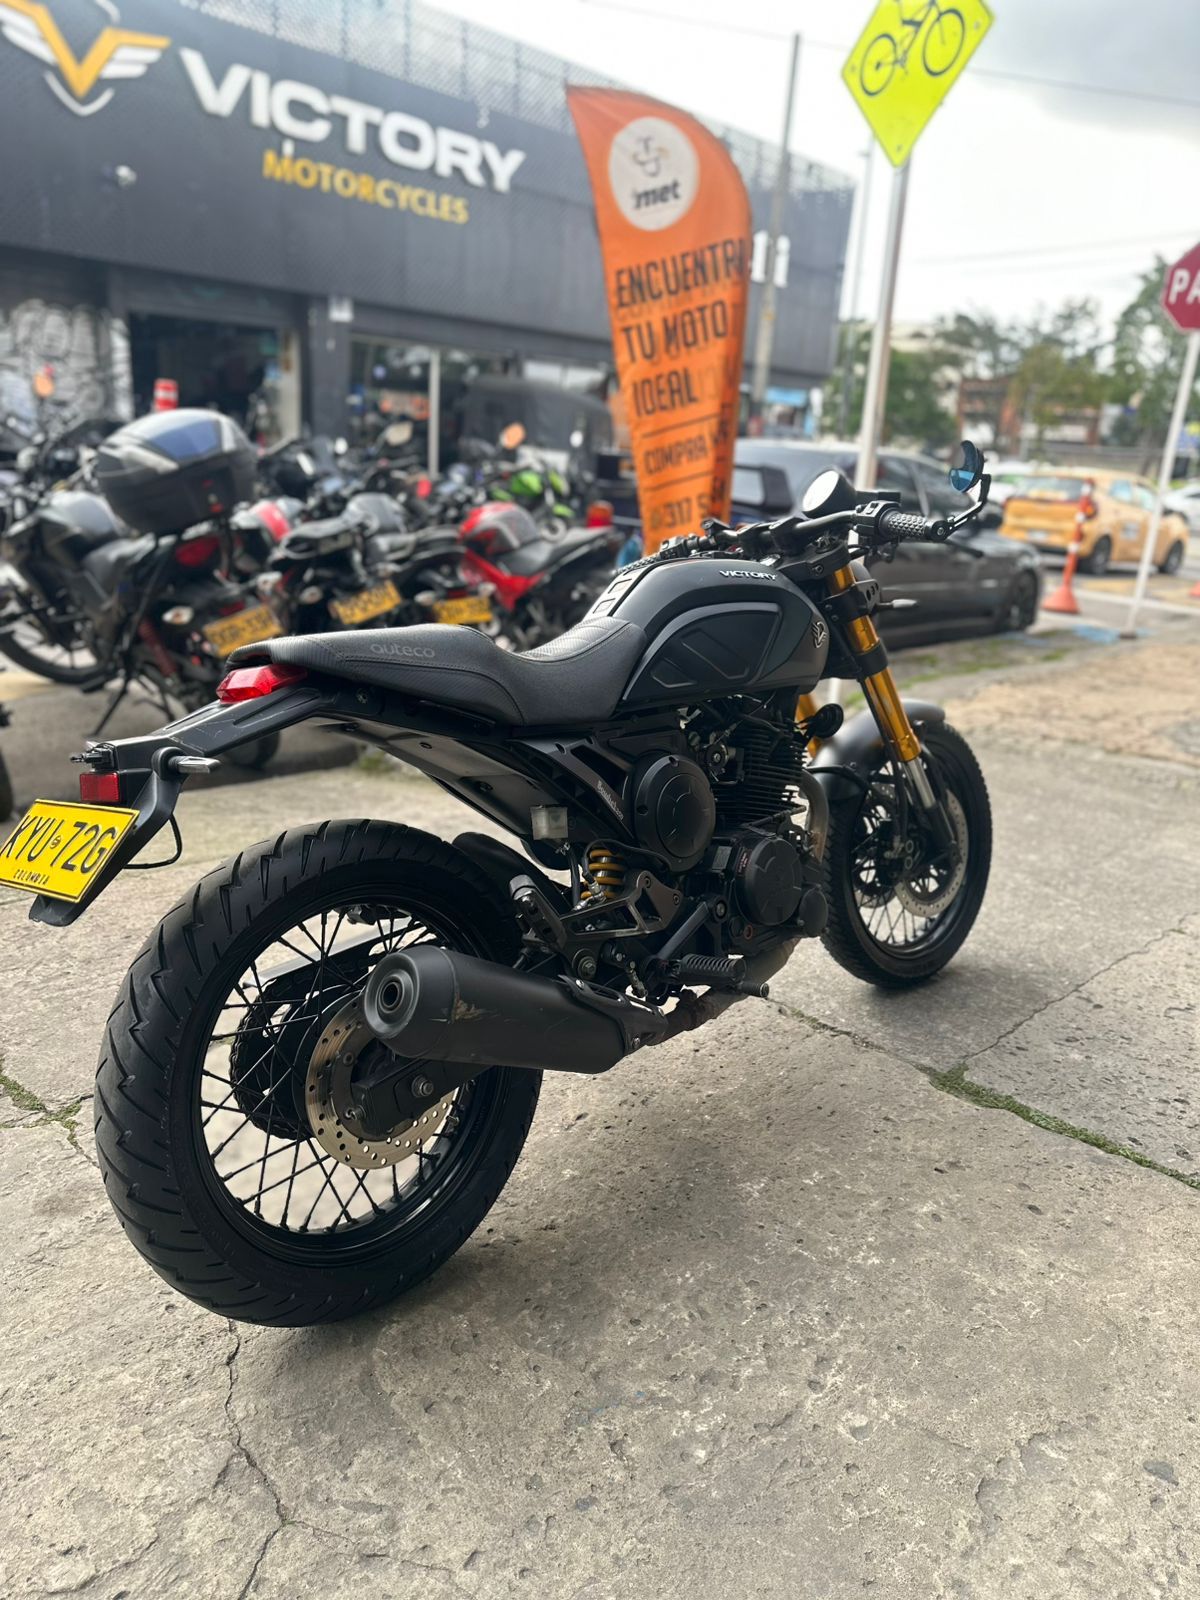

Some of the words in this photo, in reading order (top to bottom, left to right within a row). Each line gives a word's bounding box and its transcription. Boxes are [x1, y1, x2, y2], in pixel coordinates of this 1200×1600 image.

[179, 46, 527, 194] VICTORY
[261, 148, 470, 225] MOTORCYCLES
[622, 320, 656, 364] TU
[662, 299, 728, 355] MOTO
[632, 367, 699, 416] IDEAL
[643, 434, 708, 476] COMPRA
[719, 570, 777, 580] VICTORY
[369, 643, 436, 658] auteco
[0, 815, 65, 862] KYU
[50, 821, 118, 874] 72G
[13, 868, 50, 885] COLOMBIA
